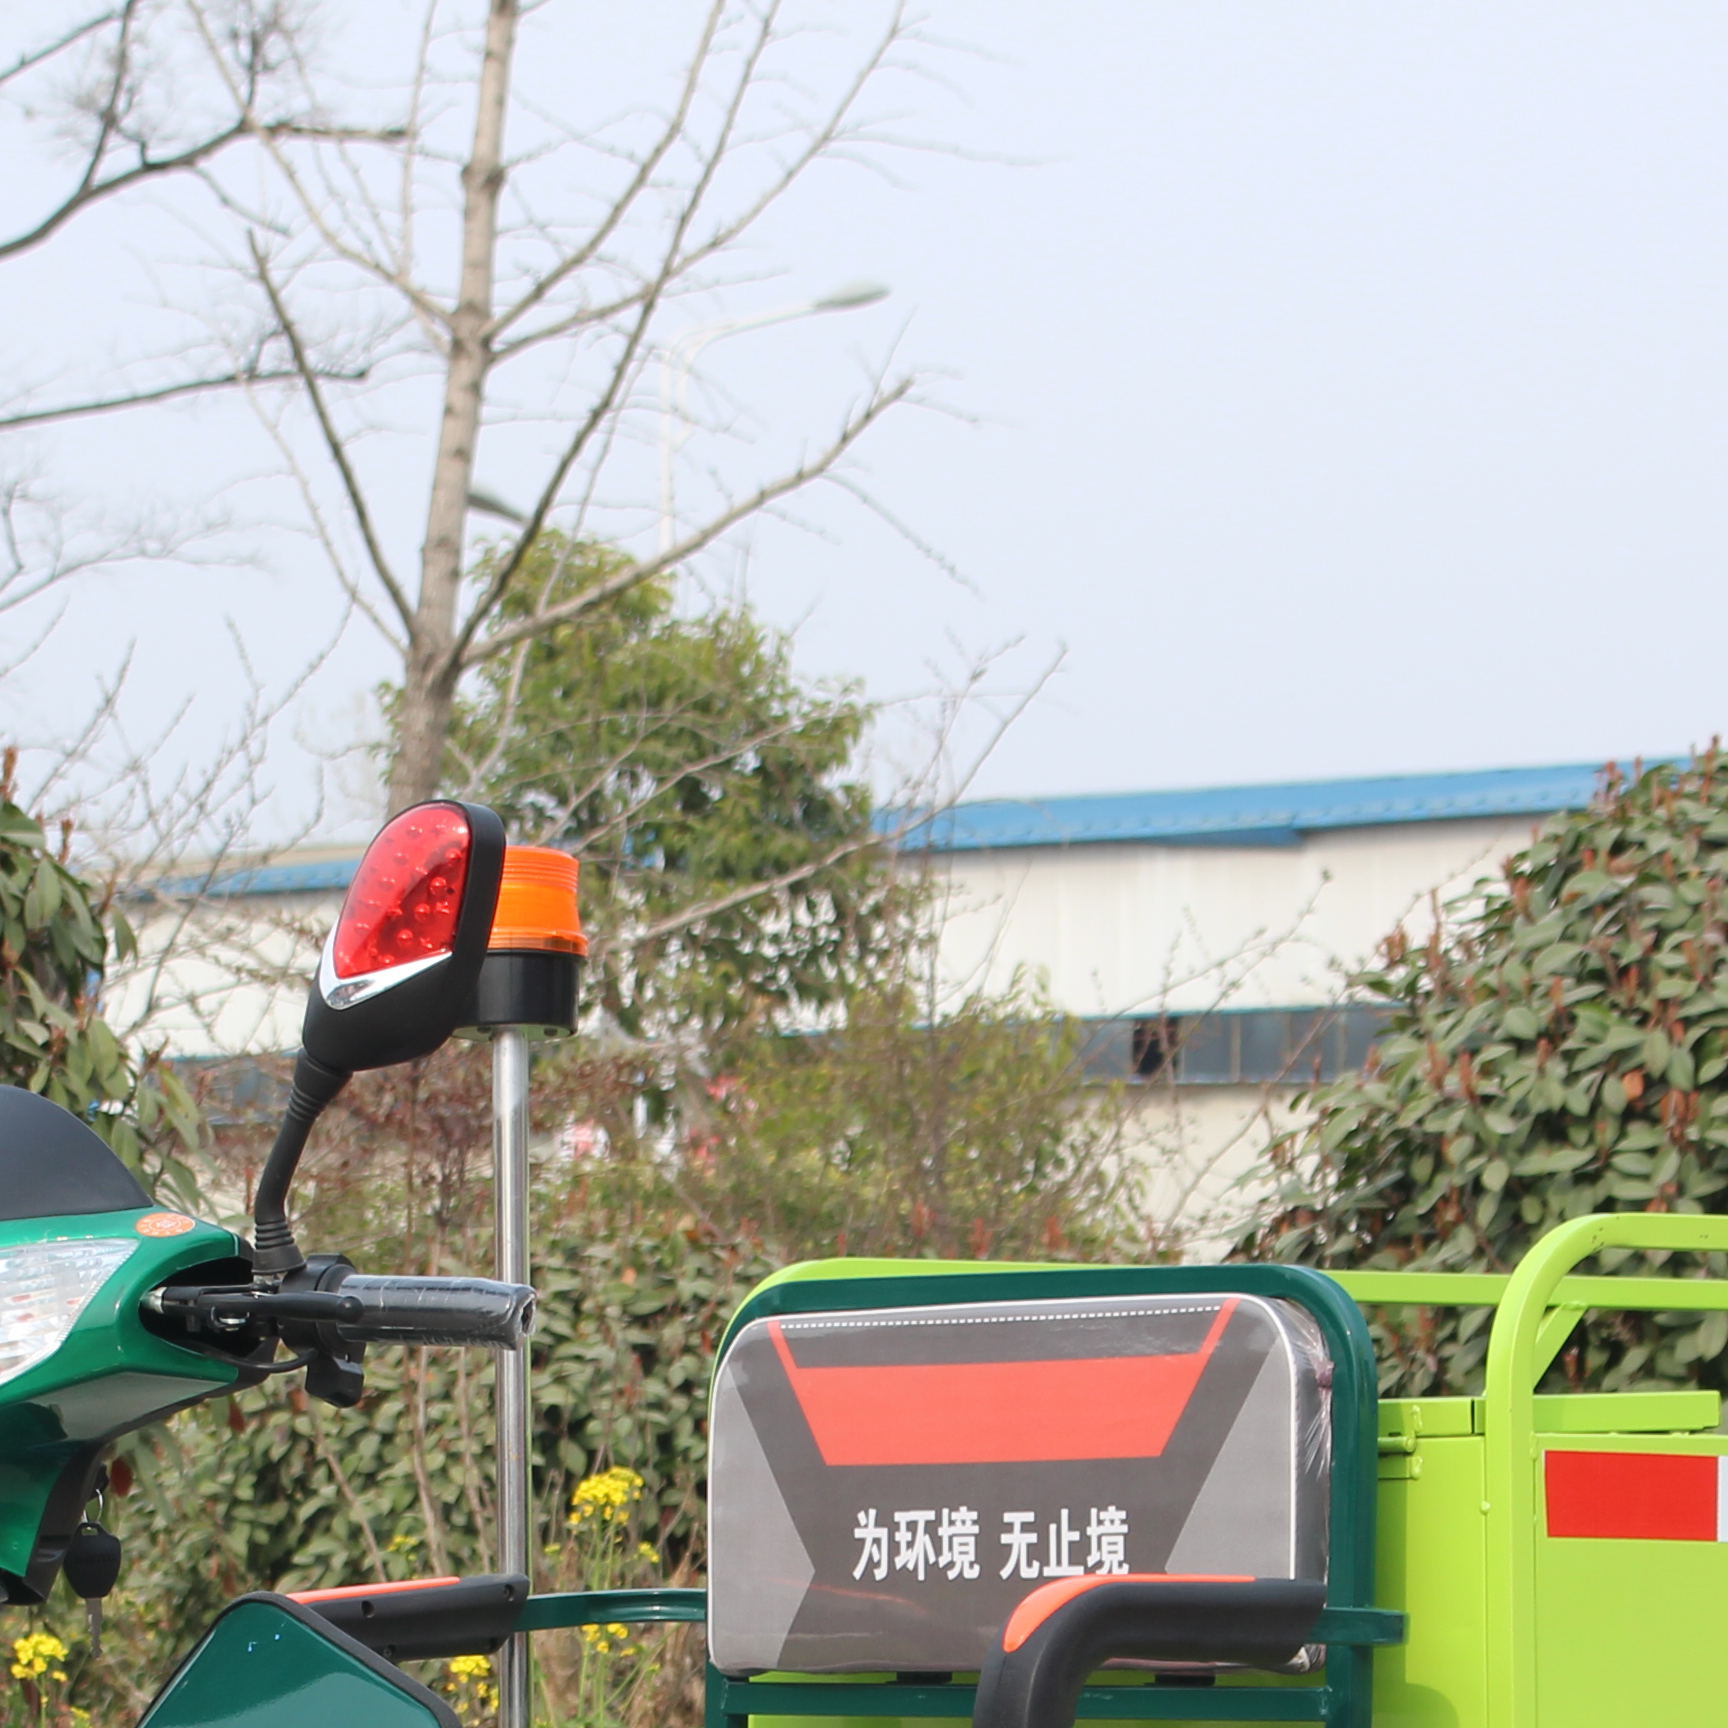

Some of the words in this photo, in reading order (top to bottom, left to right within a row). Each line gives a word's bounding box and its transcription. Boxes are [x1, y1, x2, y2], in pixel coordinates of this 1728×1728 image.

[852, 1505, 981, 1581] 为环境
[999, 1505, 1130, 1580] 无止境
